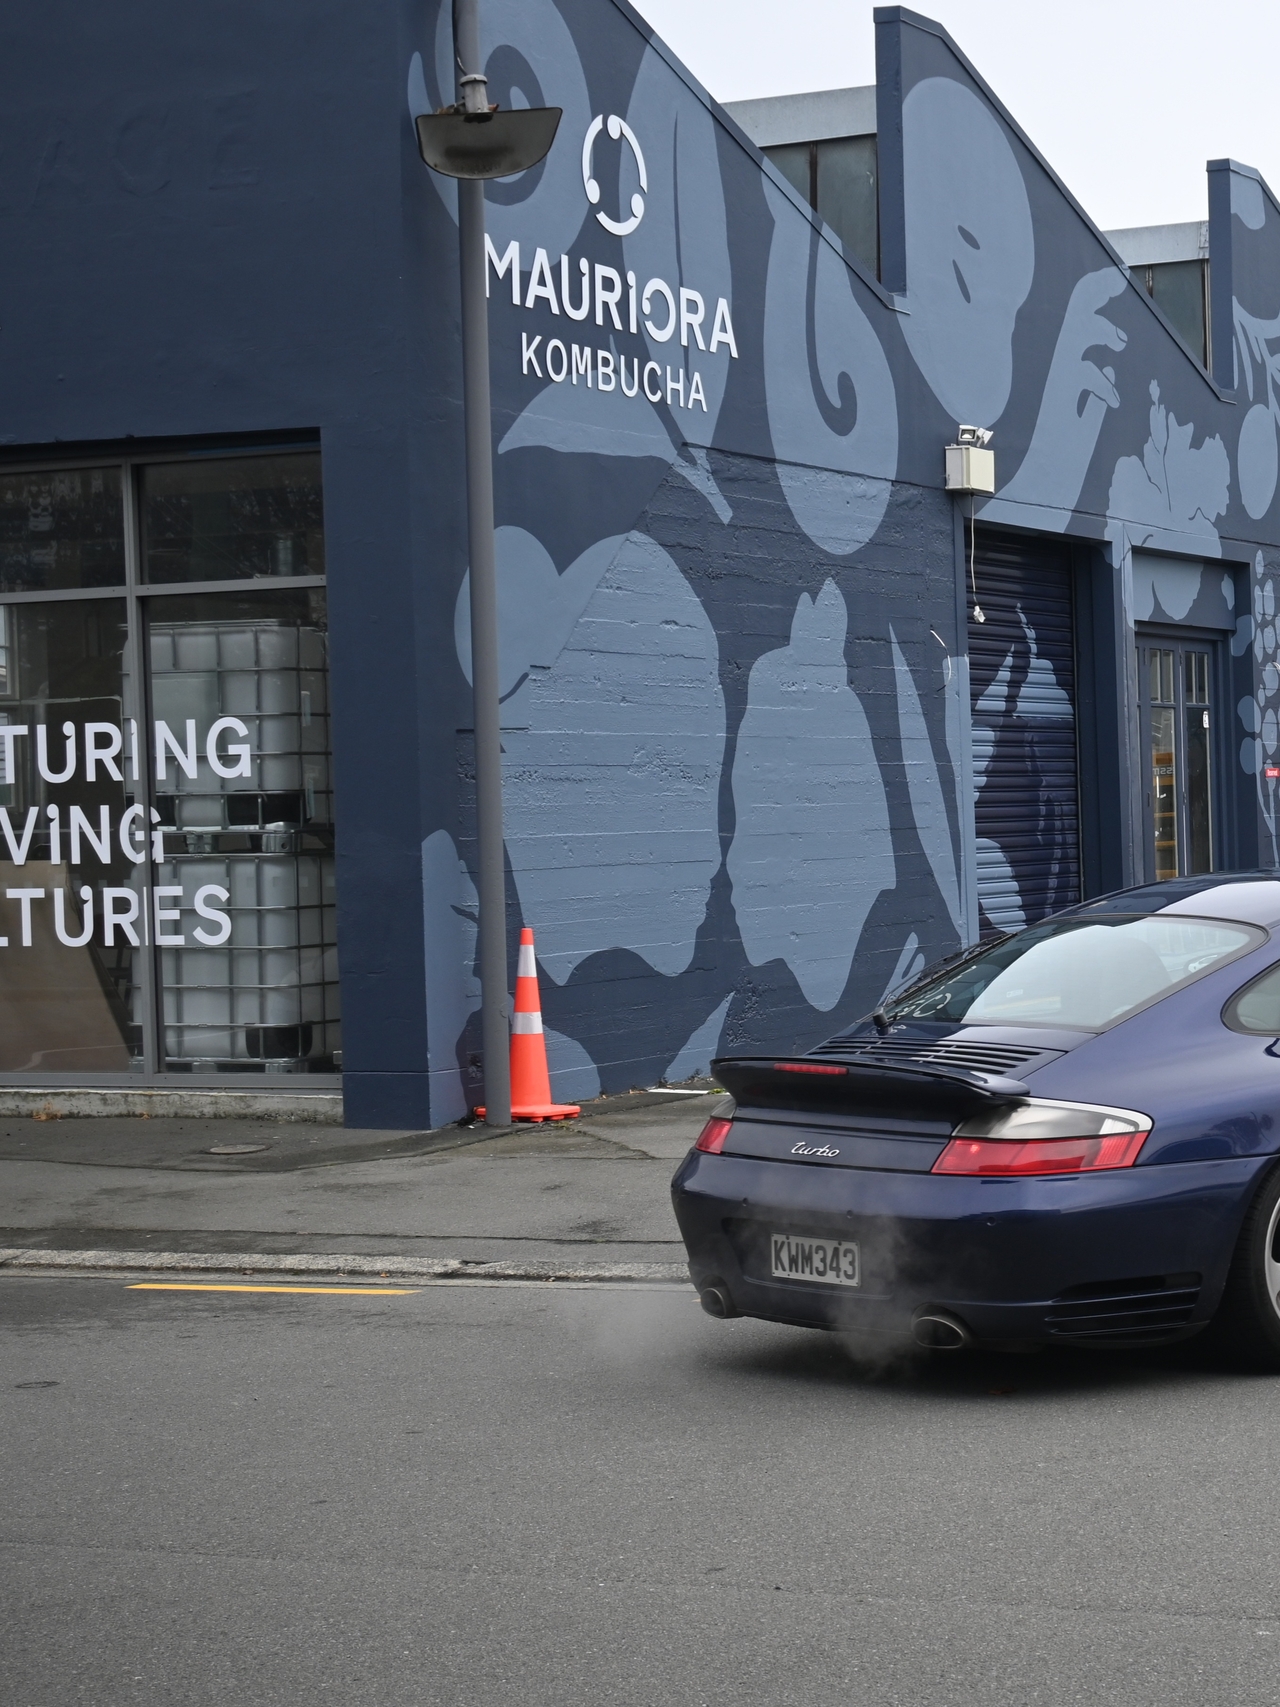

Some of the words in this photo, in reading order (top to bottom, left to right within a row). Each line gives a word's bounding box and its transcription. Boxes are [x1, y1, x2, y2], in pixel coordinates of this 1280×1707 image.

[522, 332, 708, 412] KOMBUCHA
[0, 884, 232, 947] TURES
[791, 1141, 840, 1157] turbo
[773, 1239, 856, 1281] KWM343
